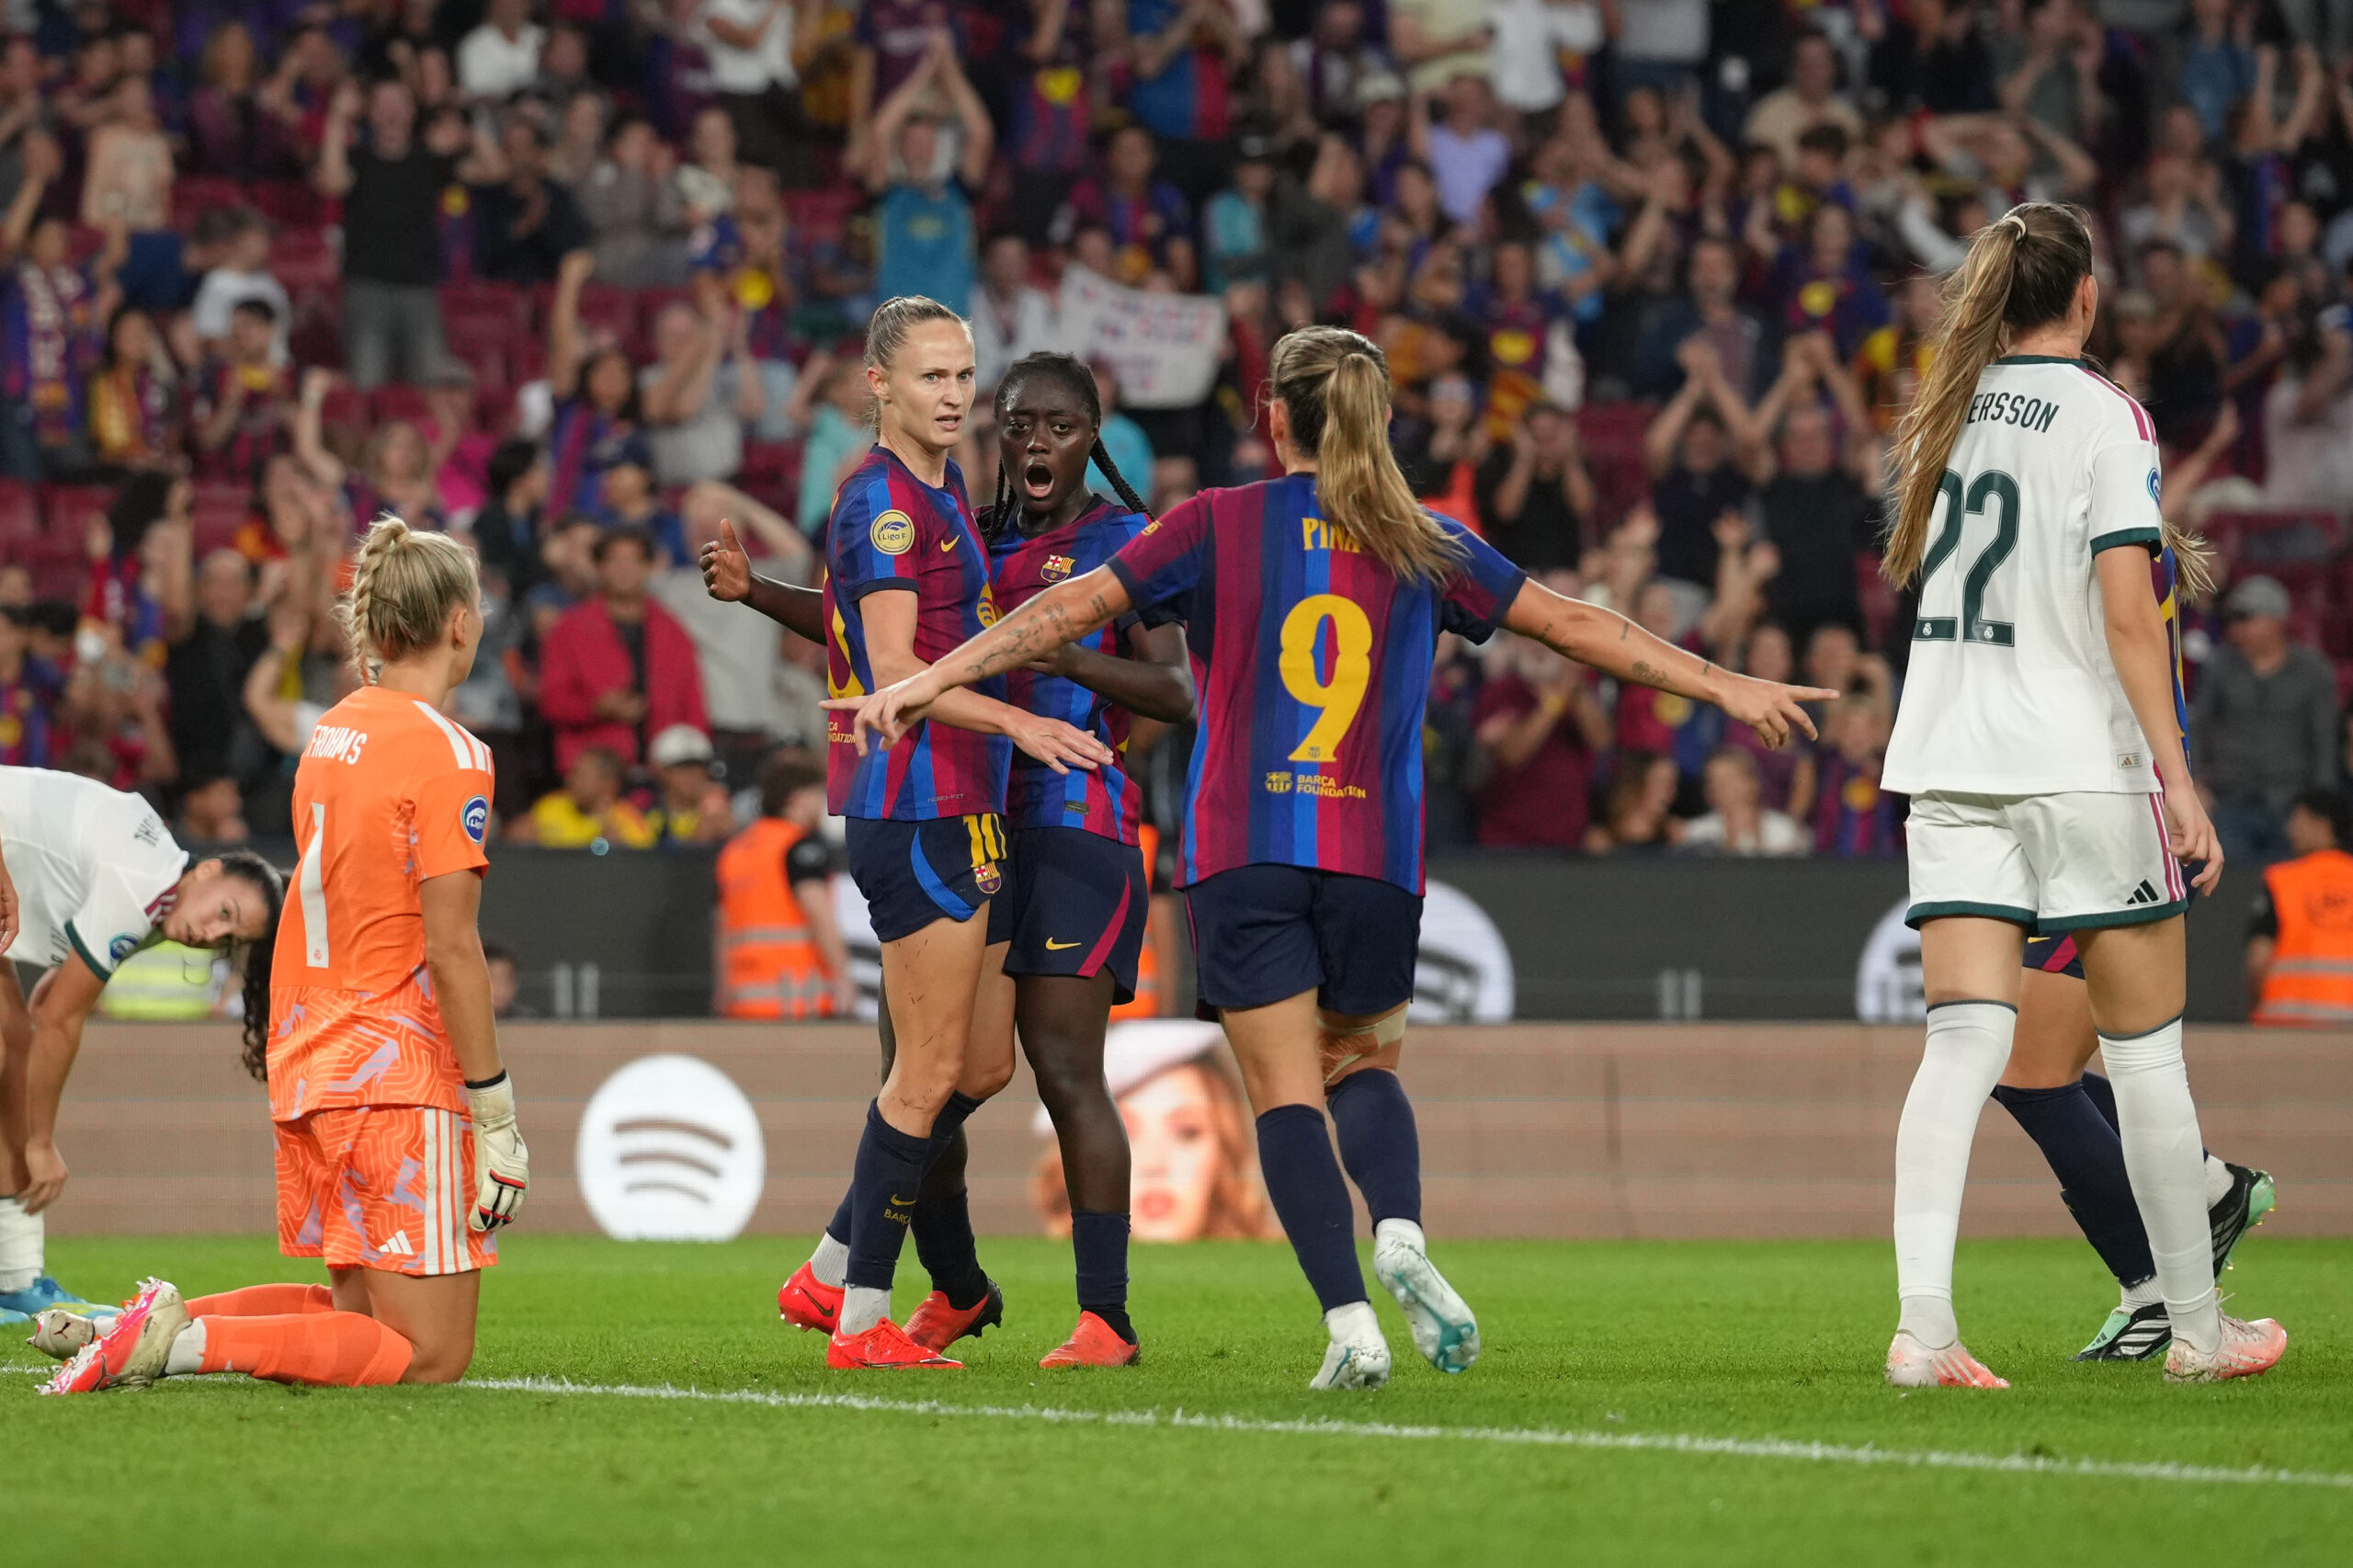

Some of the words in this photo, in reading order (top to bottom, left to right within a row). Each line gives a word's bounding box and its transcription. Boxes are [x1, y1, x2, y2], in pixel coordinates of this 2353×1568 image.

[1967, 392, 2060, 433] ERSSON
[1911, 468, 2020, 646] 22
[1279, 594, 1372, 762] 9
[306, 724, 368, 765] FROHMS
[828, 733, 856, 743] NDATION
[1297, 775, 1336, 788] BARÇA
[300, 802, 329, 968] 1
